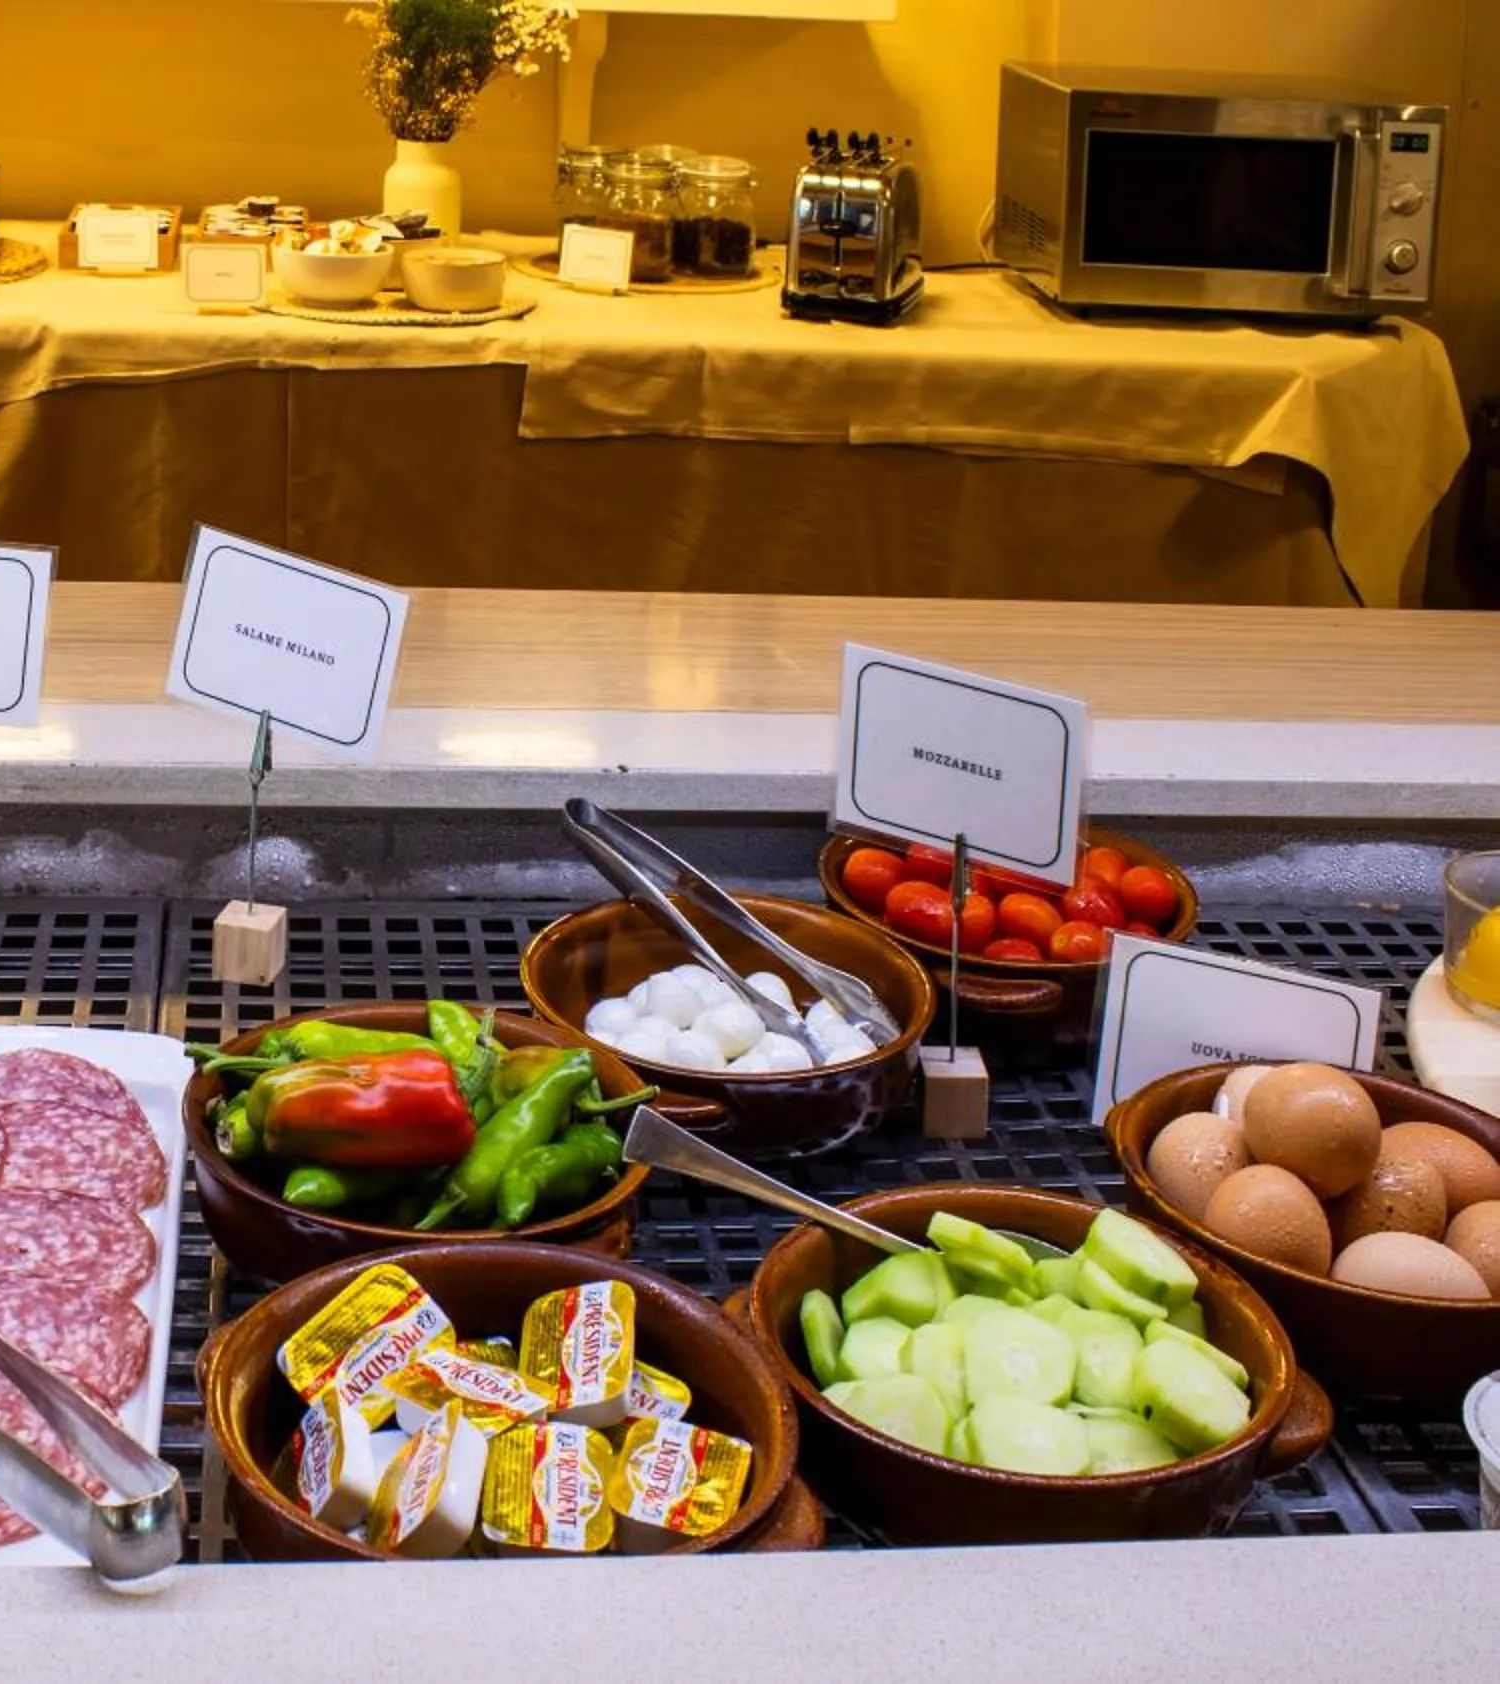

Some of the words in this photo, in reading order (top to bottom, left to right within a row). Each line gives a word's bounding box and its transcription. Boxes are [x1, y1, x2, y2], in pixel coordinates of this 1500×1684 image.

[235, 623, 283, 648] SALAME
[285, 640, 336, 666] MILANO
[913, 746, 1003, 781] MOZZARELLE
[1191, 1041, 1233, 1062] UOVA
